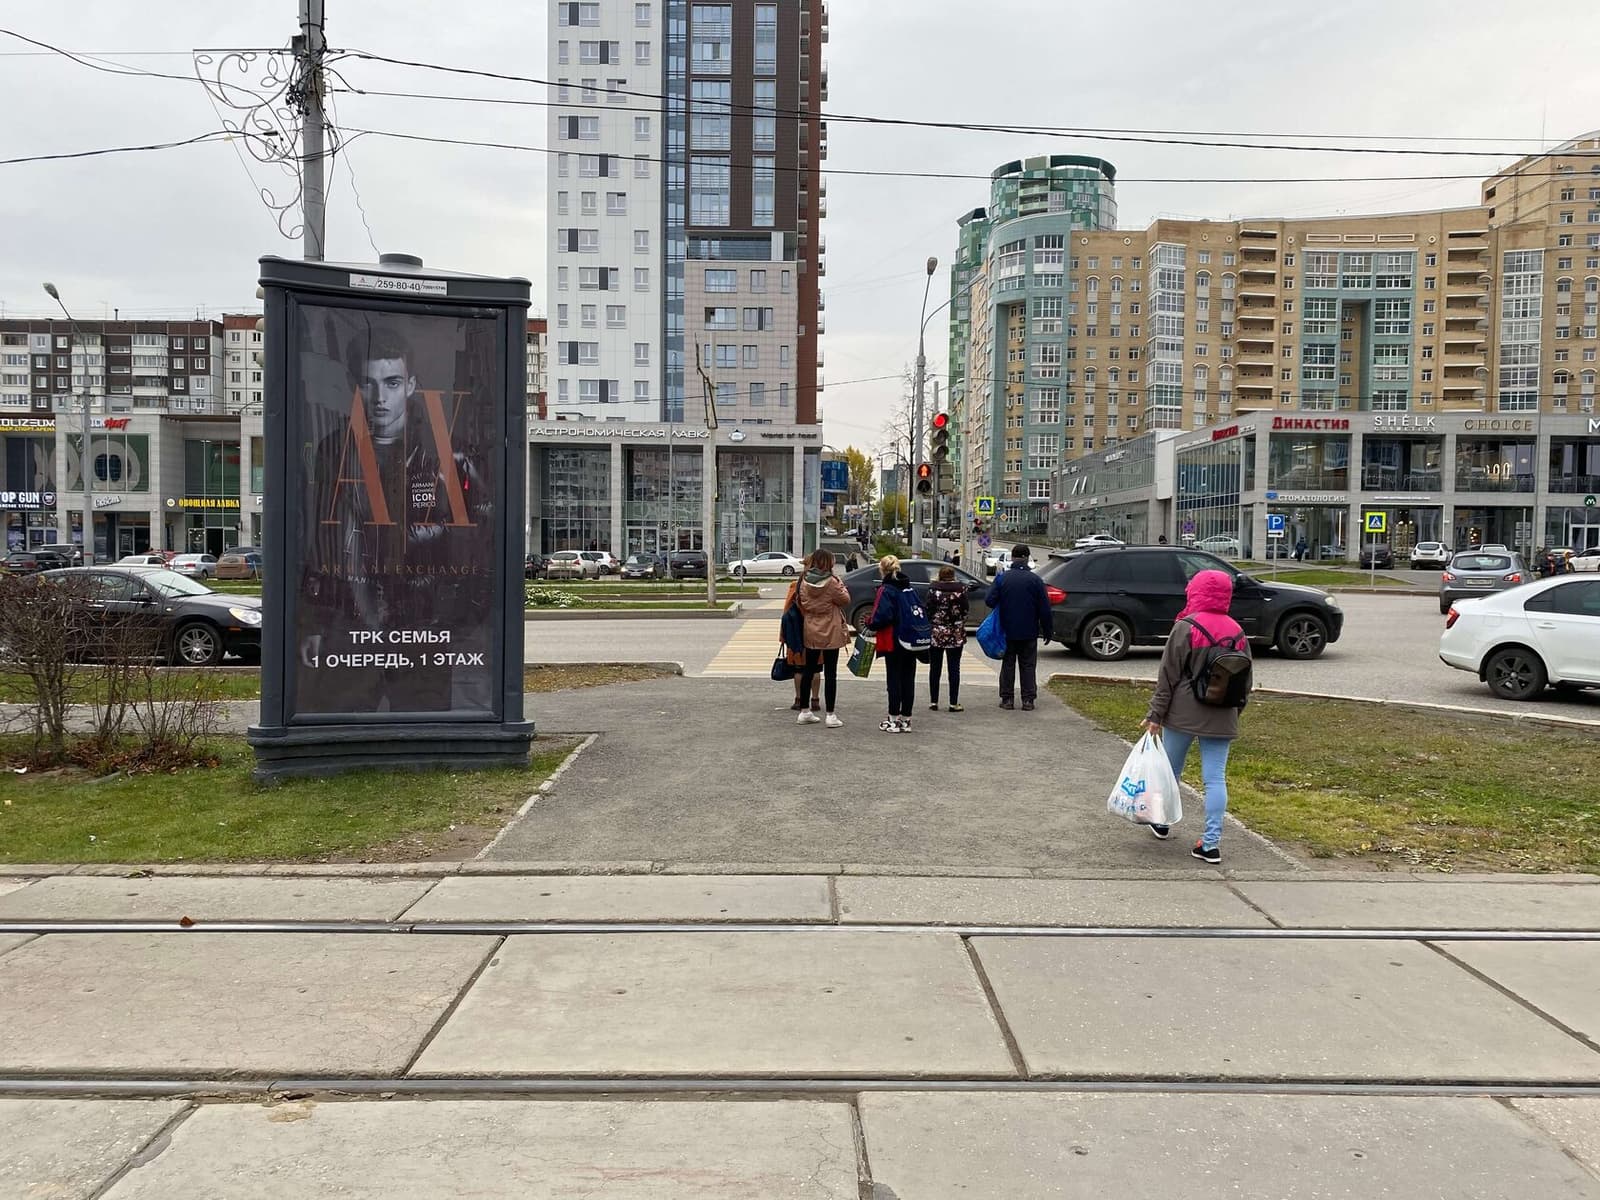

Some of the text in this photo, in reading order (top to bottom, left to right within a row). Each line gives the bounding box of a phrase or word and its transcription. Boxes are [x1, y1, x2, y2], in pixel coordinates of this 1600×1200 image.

[377, 279, 421, 291] 259-80-40
[0, 418, 56, 427] OLIZEUM
[1272, 416, 1350, 430] ДИНАСТИЯ
[1464, 419, 1533, 431] CHOICE
[528, 427, 665, 437] ГАСТРОНОМИЧЕСКАЯ
[18, 491, 40, 503] GUN
[412, 493, 435, 502] ICON
[179, 499, 239, 508] ОВОЩНАЯ ЛАВКА
[395, 564, 479, 576] EXCHANGE
[349, 630, 451, 644] ТРК СЕМЬЯ
[311, 653, 484, 669] 1 ОЧЕРЕДЬ, 1 ЭТАЖ
